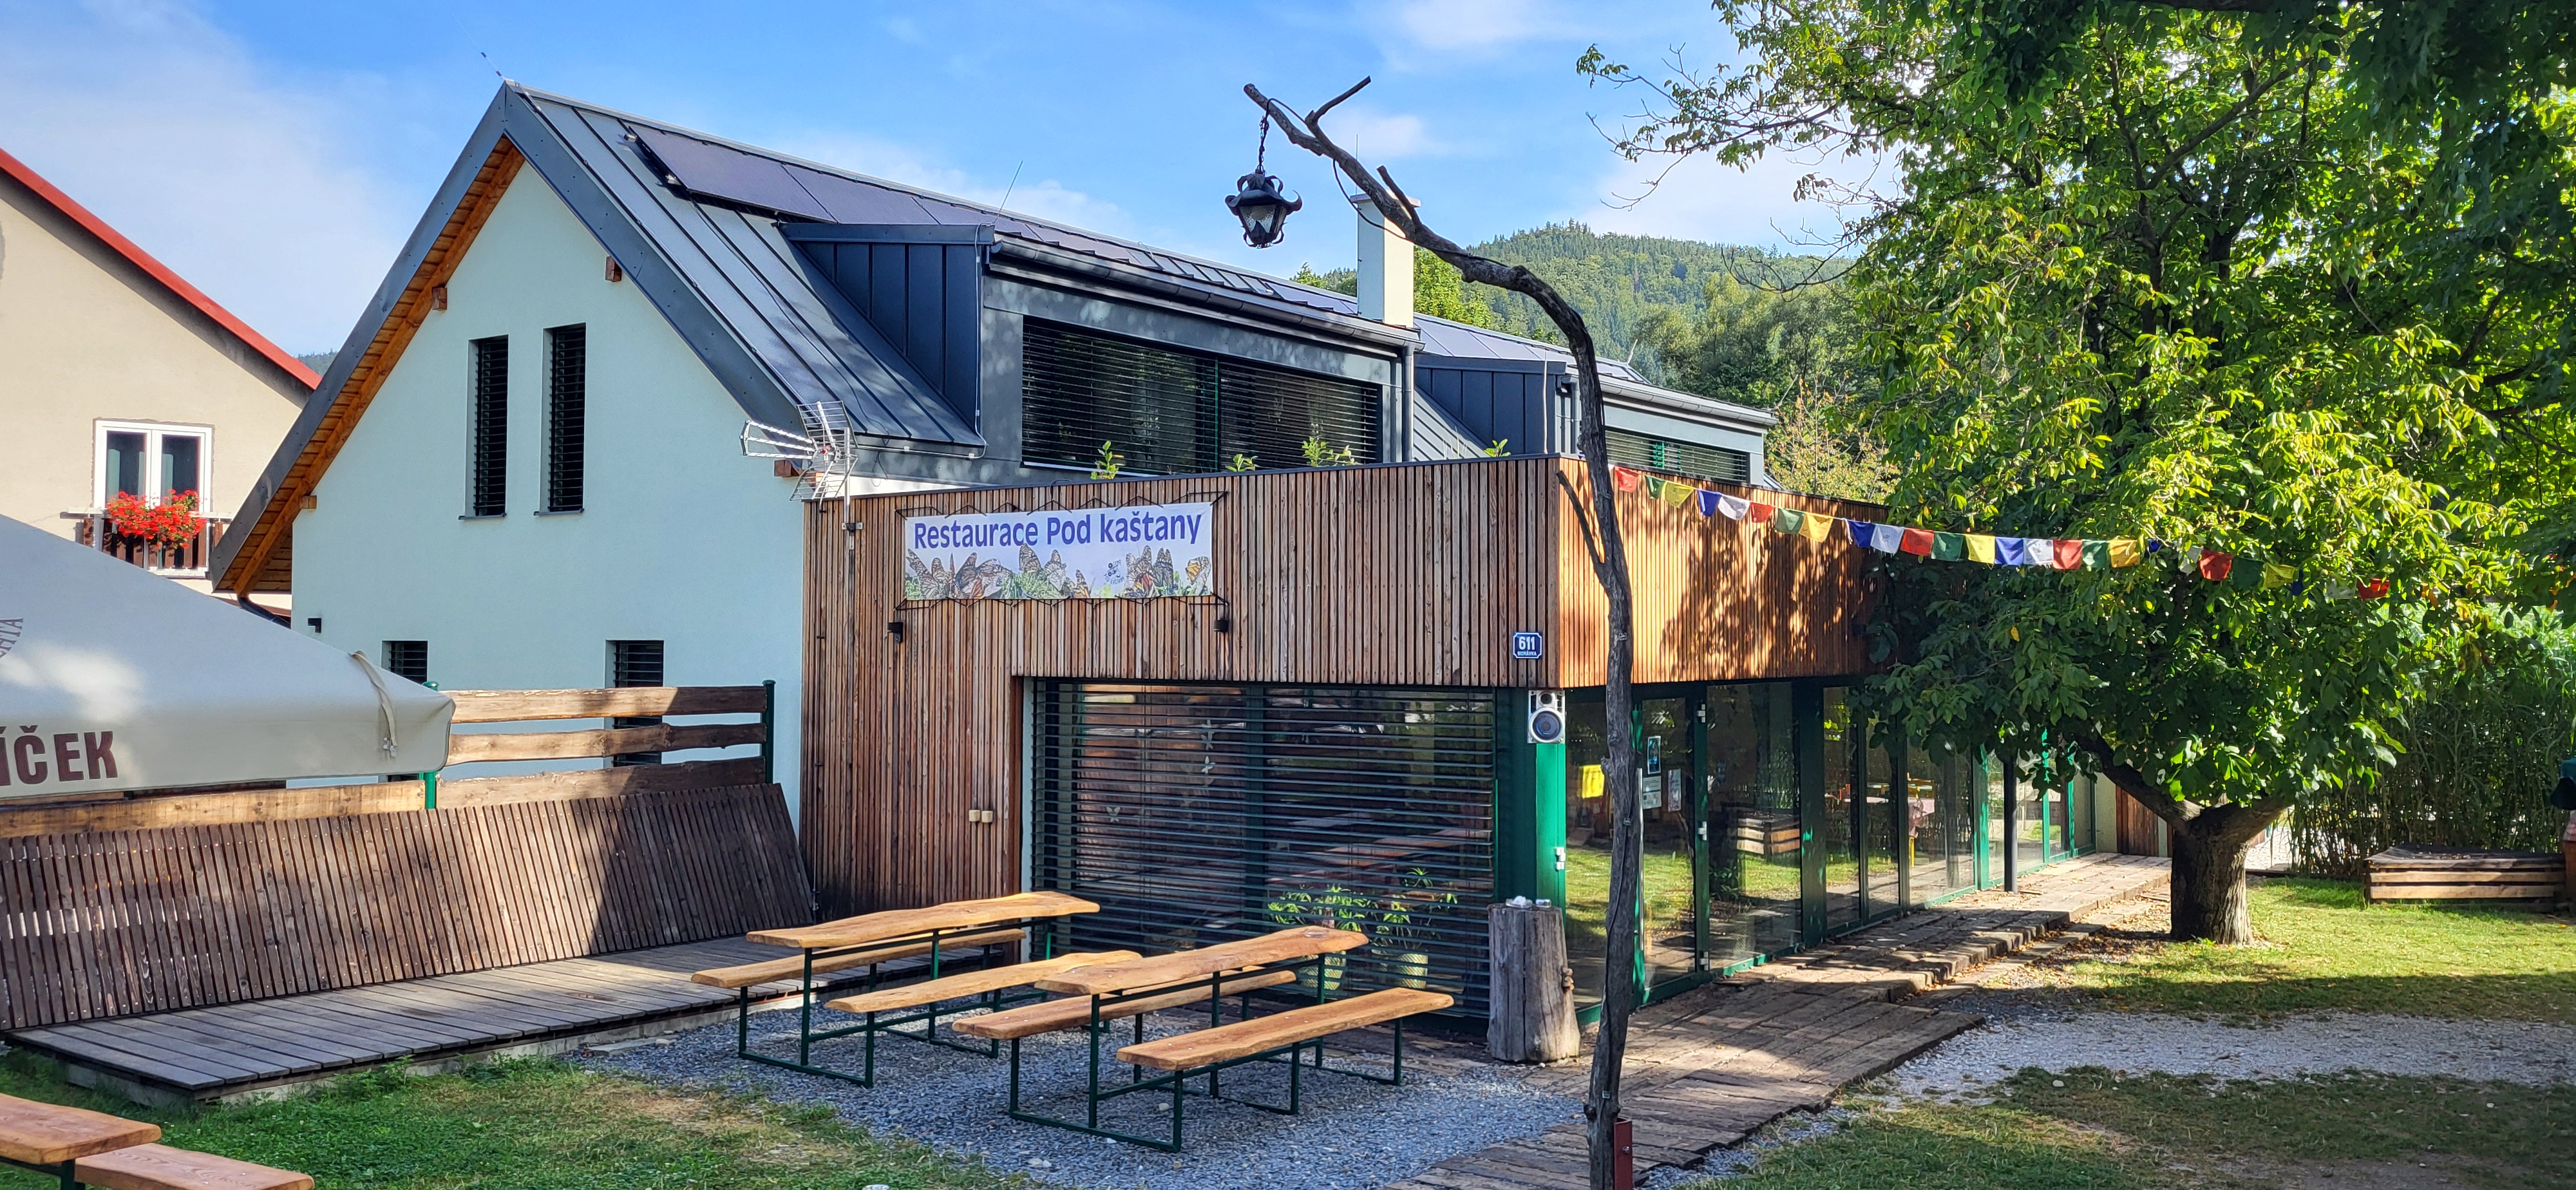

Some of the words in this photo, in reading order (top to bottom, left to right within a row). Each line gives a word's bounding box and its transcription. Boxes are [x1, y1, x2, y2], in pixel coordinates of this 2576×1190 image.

[914, 520, 1038, 549] Restaurace
[1046, 514, 1091, 545] Pod
[1100, 511, 1202, 544] kaštany
[1519, 636, 1535, 650] 611
